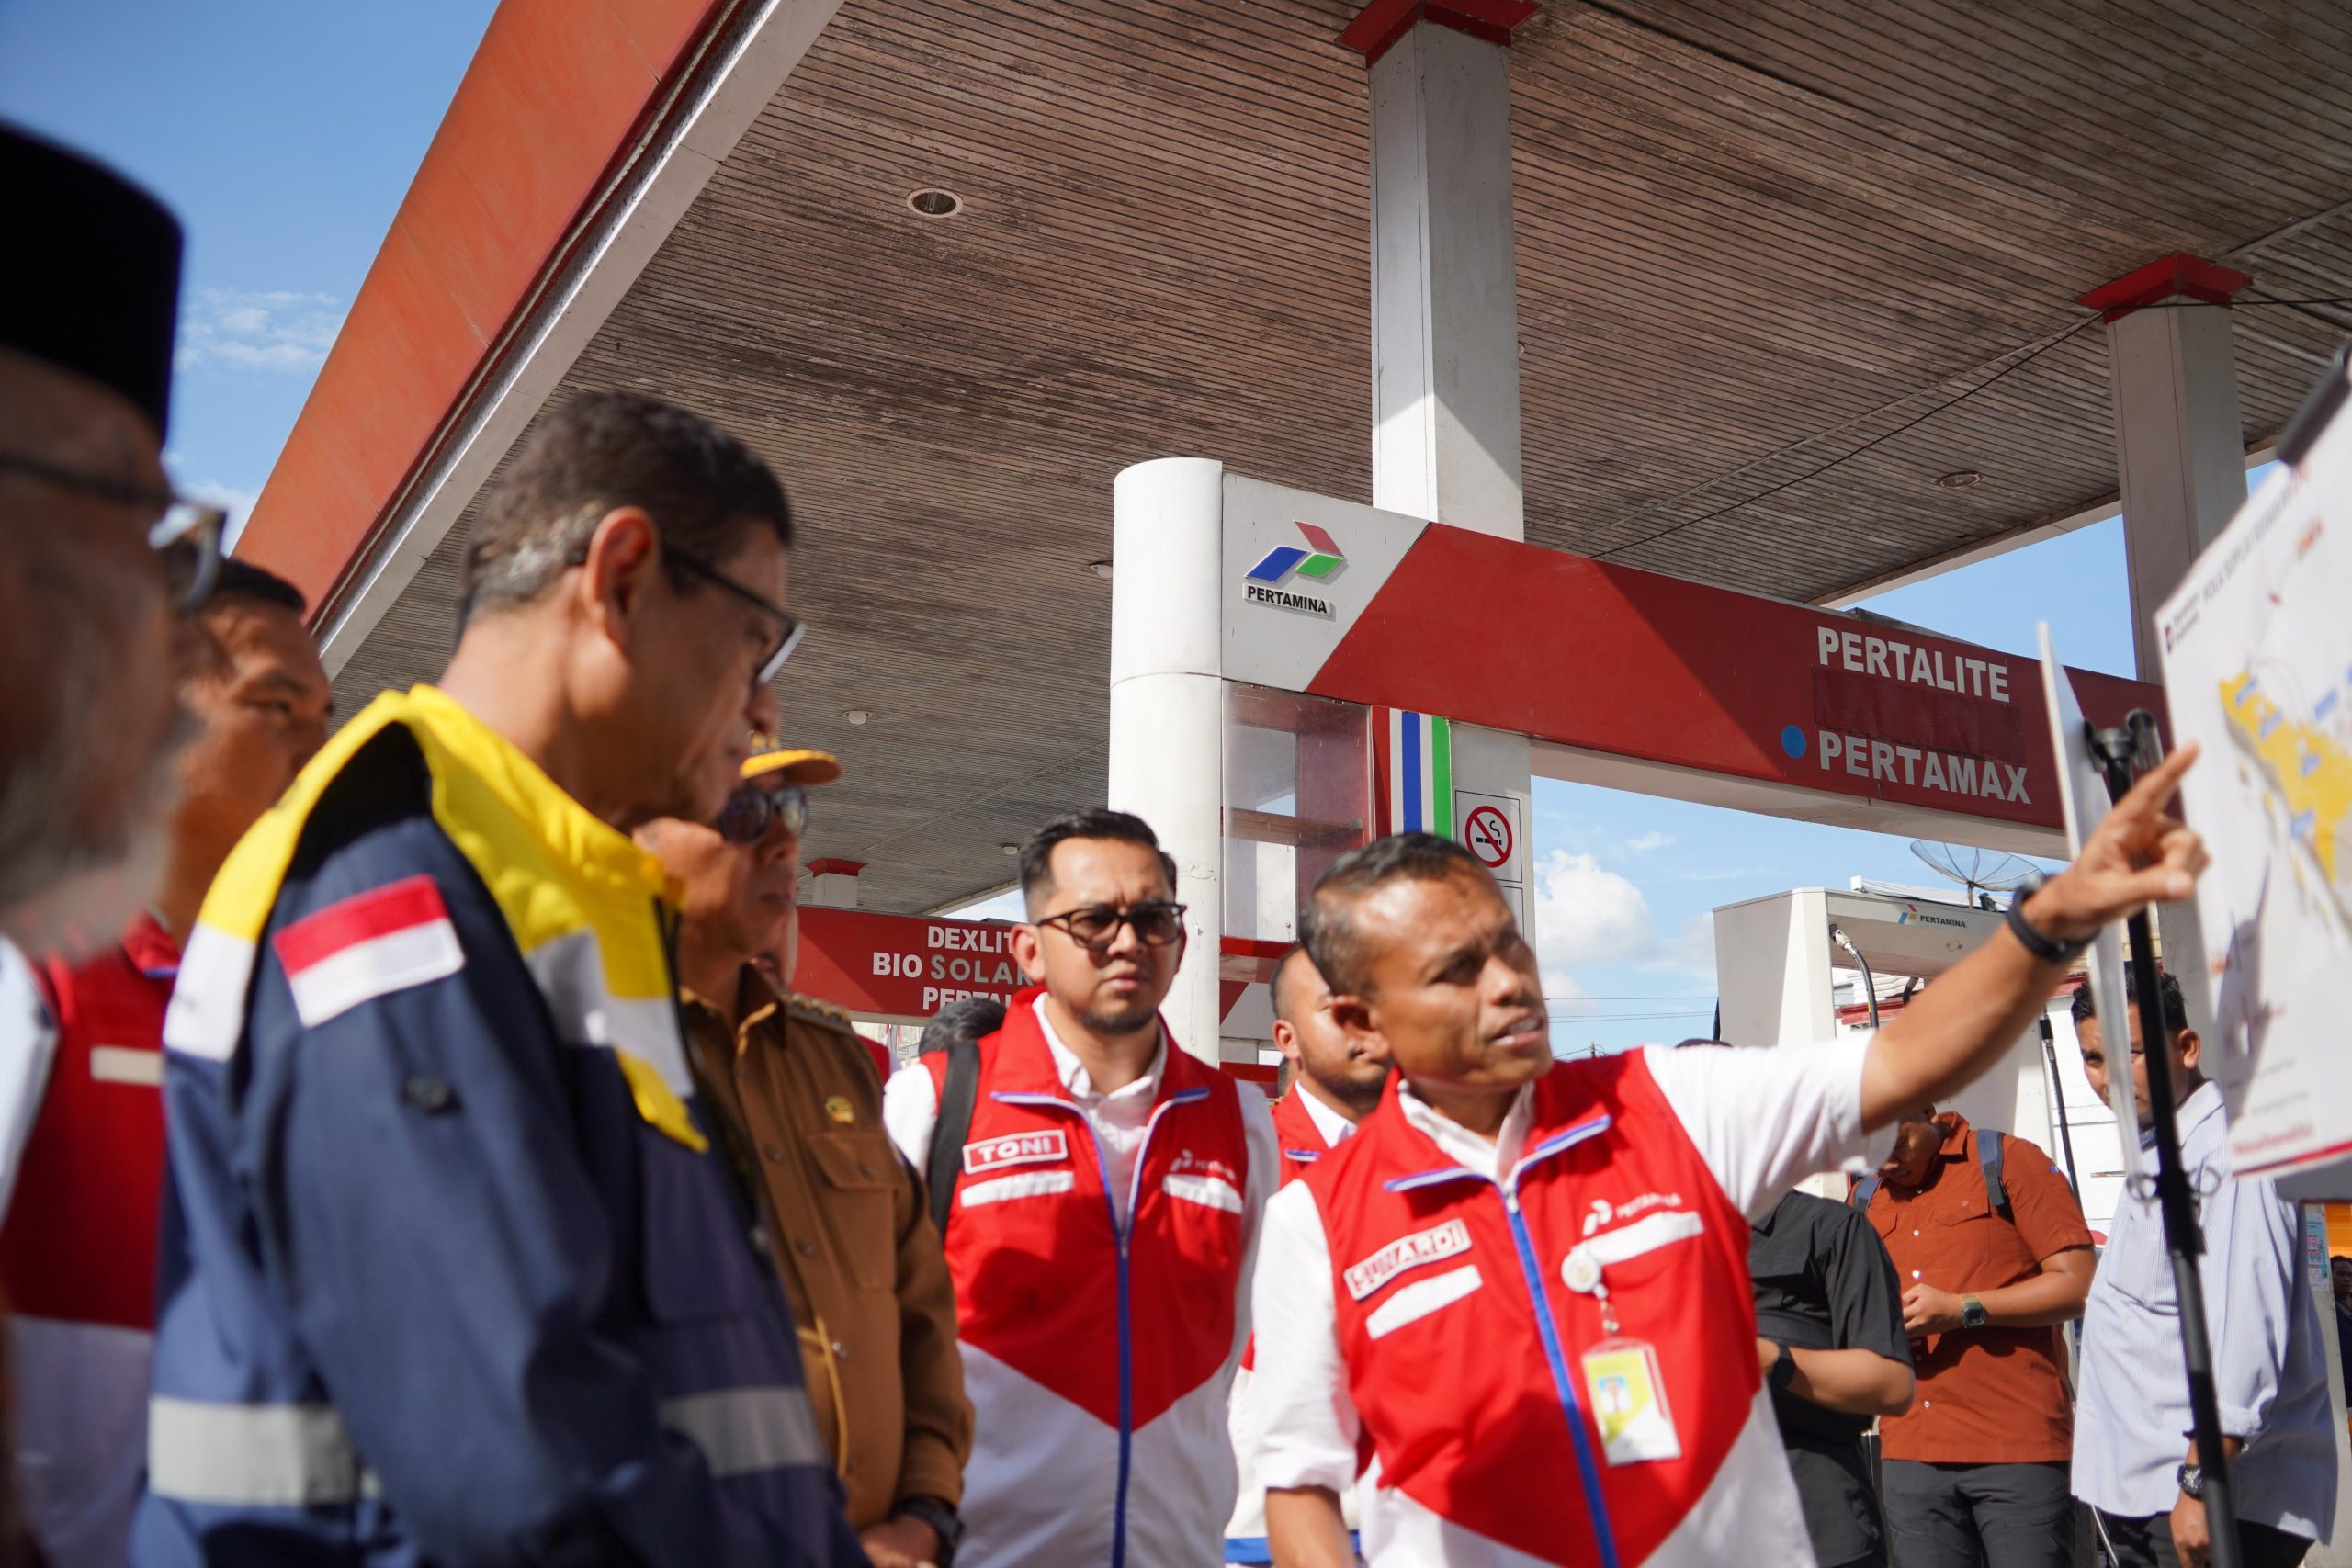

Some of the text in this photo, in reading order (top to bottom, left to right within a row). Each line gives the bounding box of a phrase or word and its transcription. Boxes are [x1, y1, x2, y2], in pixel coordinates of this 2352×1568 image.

[1248, 585, 1327, 614] PERTAMINA
[1818, 626, 2010, 703] PERTALITE
[1819, 729, 2031, 805] PERTAMAX
[1920, 915, 1966, 928] PERTAMINA
[928, 926, 1014, 954] DEXLIT
[873, 952, 922, 978] BIO
[978, 1136, 1051, 1163] TONI
